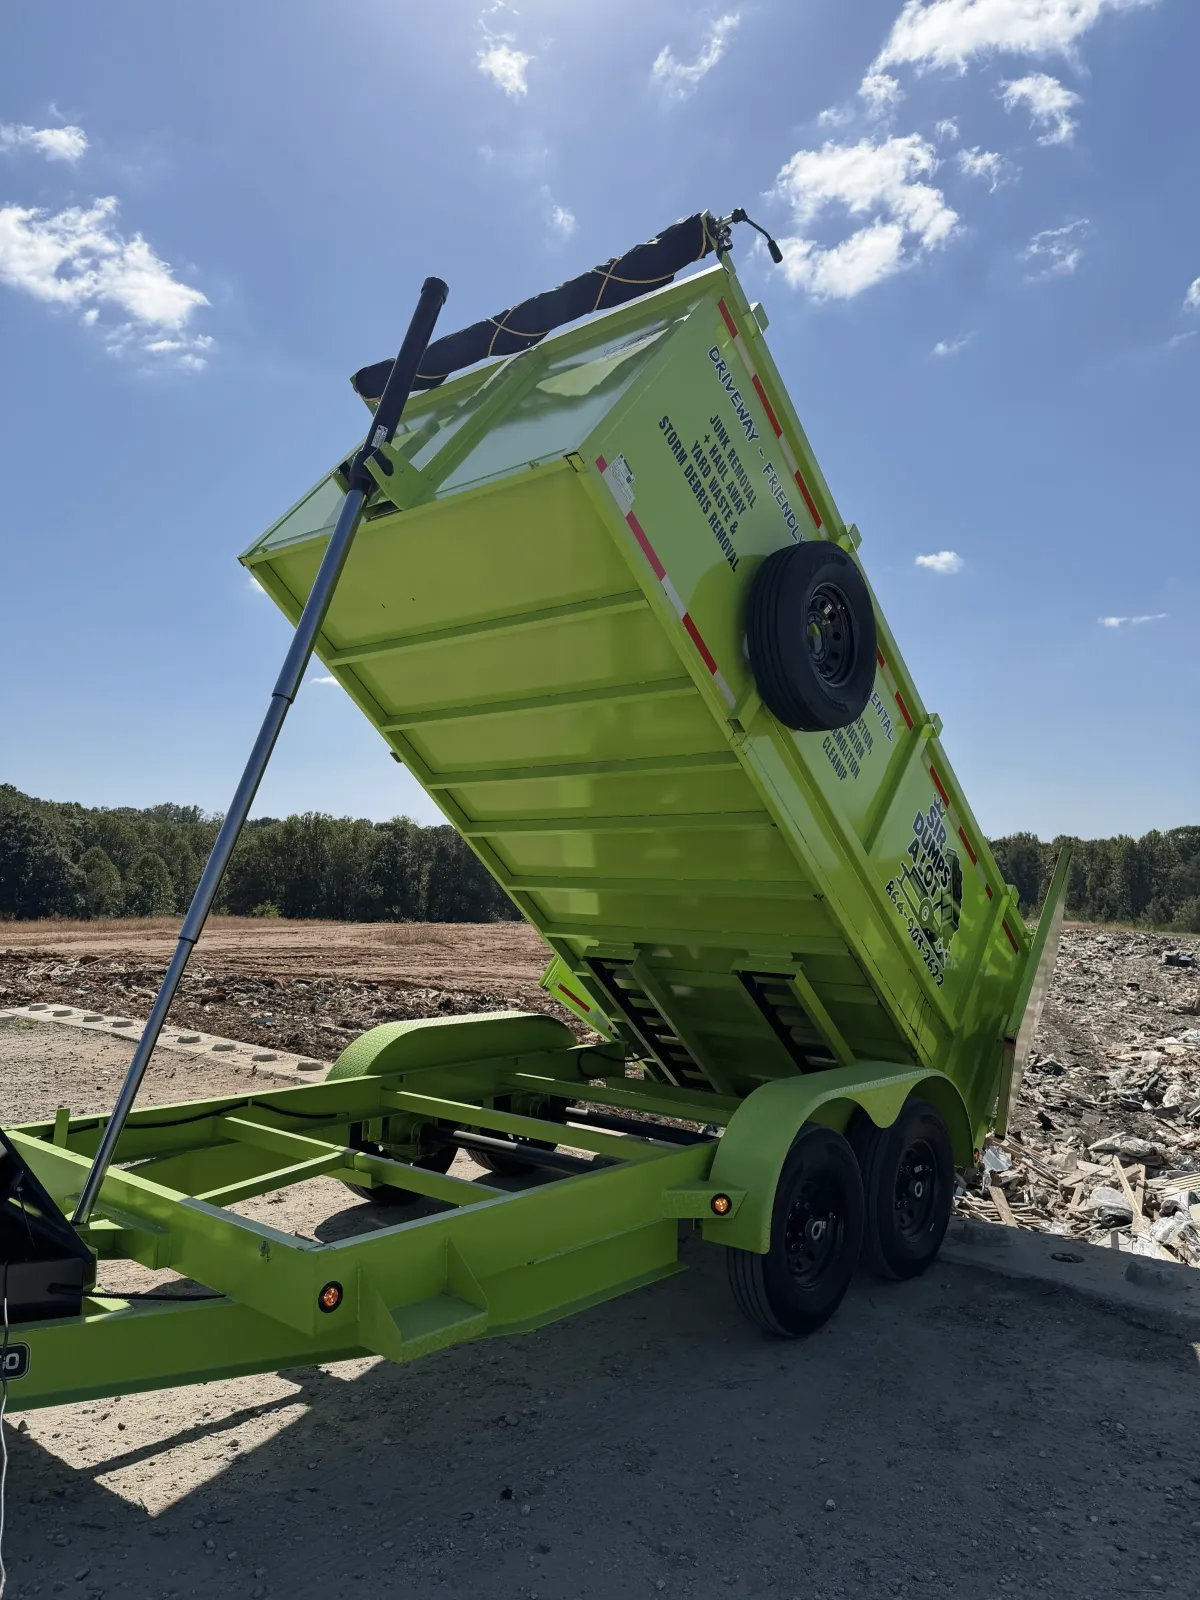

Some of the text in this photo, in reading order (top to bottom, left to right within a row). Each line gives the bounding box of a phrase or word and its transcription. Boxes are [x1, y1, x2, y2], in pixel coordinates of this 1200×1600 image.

[708, 345, 760, 442] DRIVEWAY
[658, 415, 741, 573] STORM DEBRIS REMOVAL
[690, 440, 739, 536] YARD WASTE &
[708, 444, 728, 482] HAUL
[726, 478, 747, 516] AWAY
[710, 414, 757, 509] JUNK REMOVAL
[830, 728, 861, 780] EMOLITION
[870, 689, 893, 743] ENTAL
[822, 735, 848, 781] CLEANUP
[912, 809, 950, 890] DUMPS
[926, 804, 947, 853] SIR
